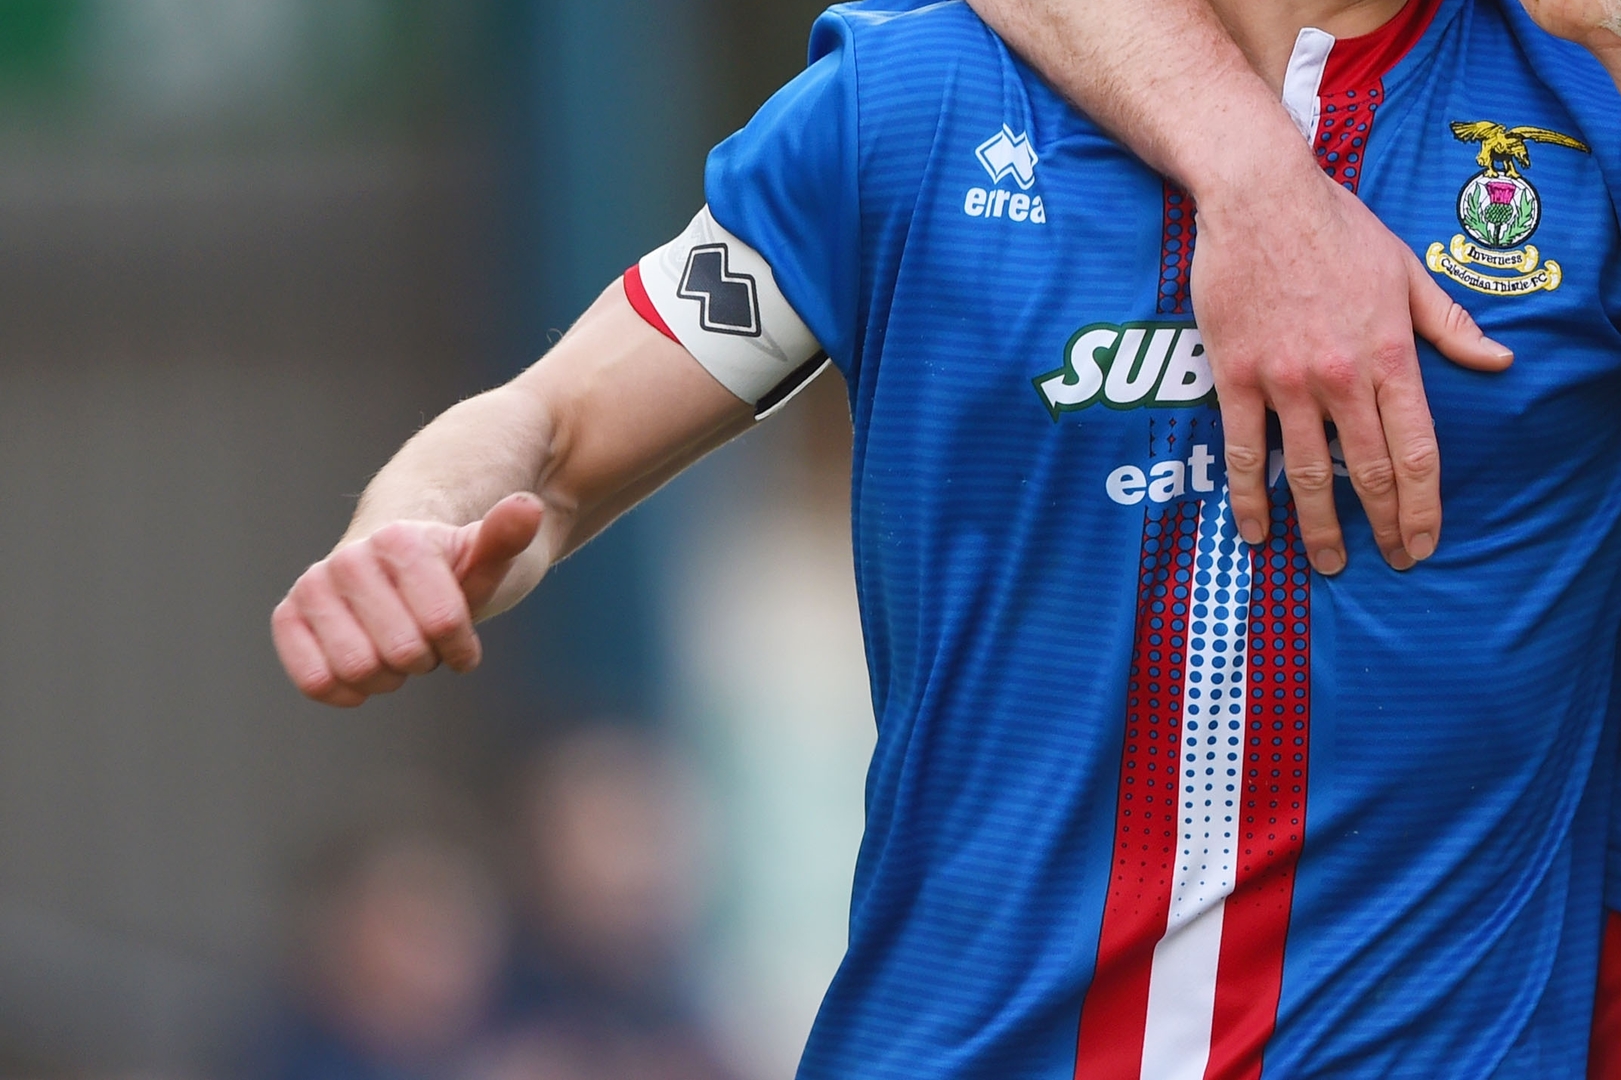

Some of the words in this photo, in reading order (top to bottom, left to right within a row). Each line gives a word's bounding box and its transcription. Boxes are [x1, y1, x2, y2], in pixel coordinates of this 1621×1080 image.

[1441, 258, 1491, 290] Caledonian
[1491, 280, 1531, 293] Thistle
[1531, 272, 1548, 287] FC
[1467, 246, 1523, 265] Inverness
[1040, 328, 1214, 409] SUB
[1105, 444, 1215, 505] eat
